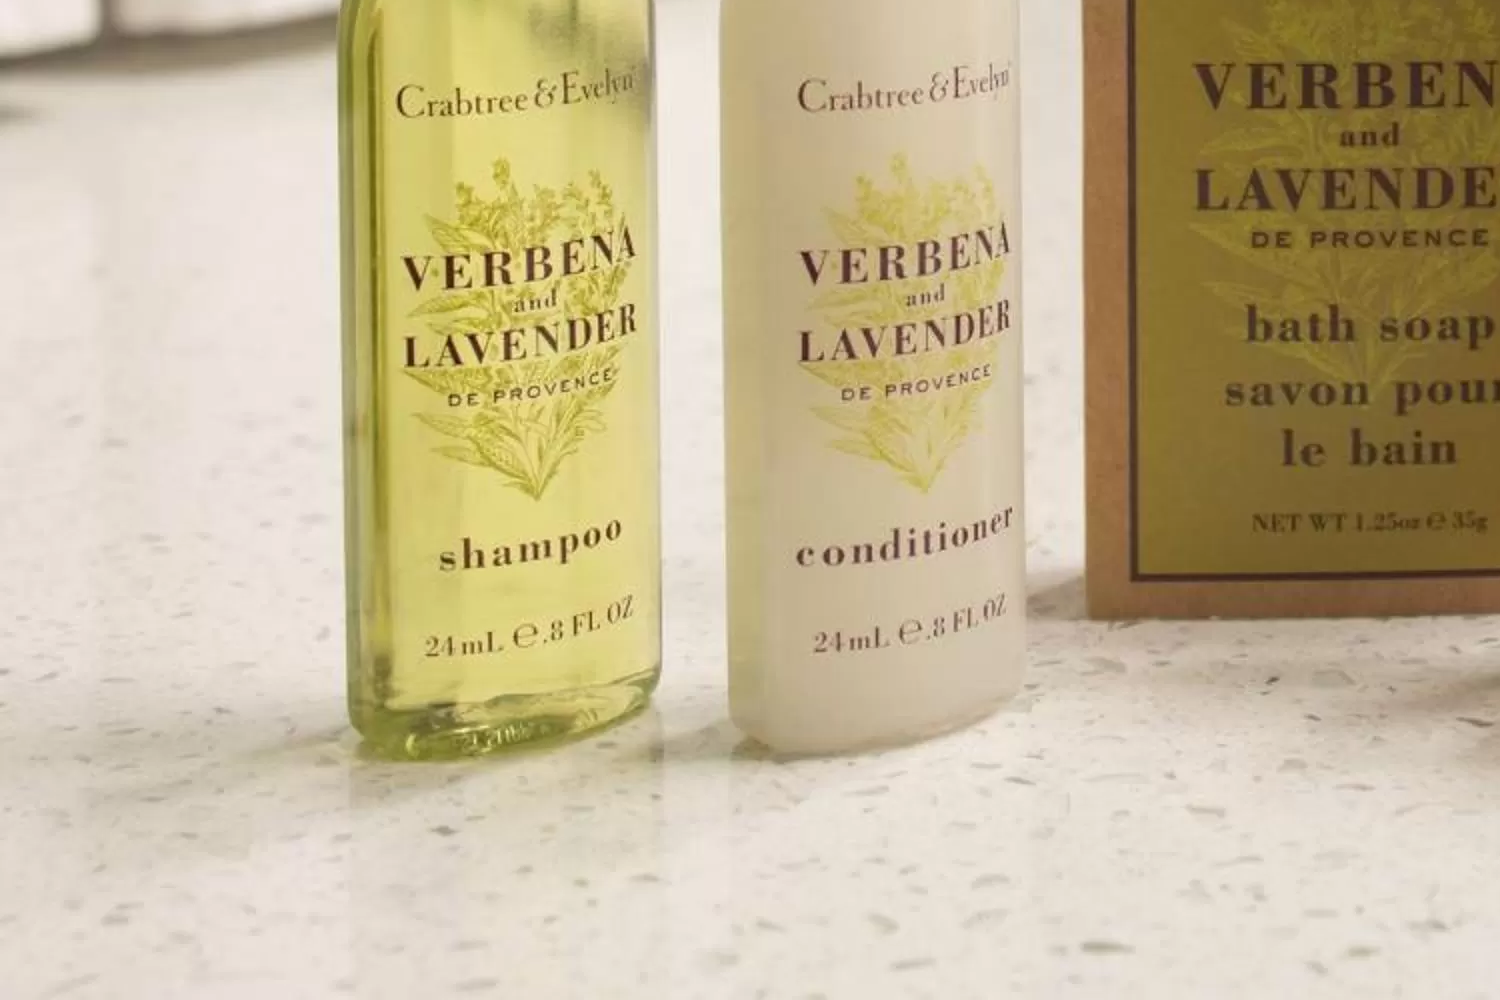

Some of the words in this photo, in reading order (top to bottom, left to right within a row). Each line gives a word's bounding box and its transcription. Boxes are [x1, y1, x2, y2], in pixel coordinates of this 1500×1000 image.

[396, 84, 529, 119] Crabtree
[798, 79, 925, 113] Crabtree
[1339, 122, 1401, 148] and
[800, 221, 1011, 286] VERBENA
[1251, 232, 1292, 249] DE
[1310, 229, 1489, 248] PROVENCE
[401, 226, 637, 292] VERBENA
[513, 293, 558, 312] and
[905, 284, 945, 307] and
[404, 303, 638, 369] LAVENDER
[799, 299, 1011, 363] LAVENDER
[1246, 305, 1356, 343] bath
[1380, 307, 1495, 349] soap
[448, 392, 481, 407] DE
[494, 371, 612, 403] PROVENCE
[841, 387, 872, 401] DE
[885, 365, 991, 397] PROVENCE
[1225, 381, 1370, 406] savon
[1281, 429, 1325, 467] le
[1350, 428, 1458, 466] bain
[796, 506, 1014, 567] conditioner
[1251, 513, 1303, 533] NET
[1310, 513, 1347, 532] WT
[1452, 511, 1488, 534] 35g
[439, 519, 622, 572] shampoo
[573, 612, 600, 636] FL
[606, 595, 634, 625] OZ
[953, 607, 979, 633] FL
[983, 593, 1006, 621] OZ
